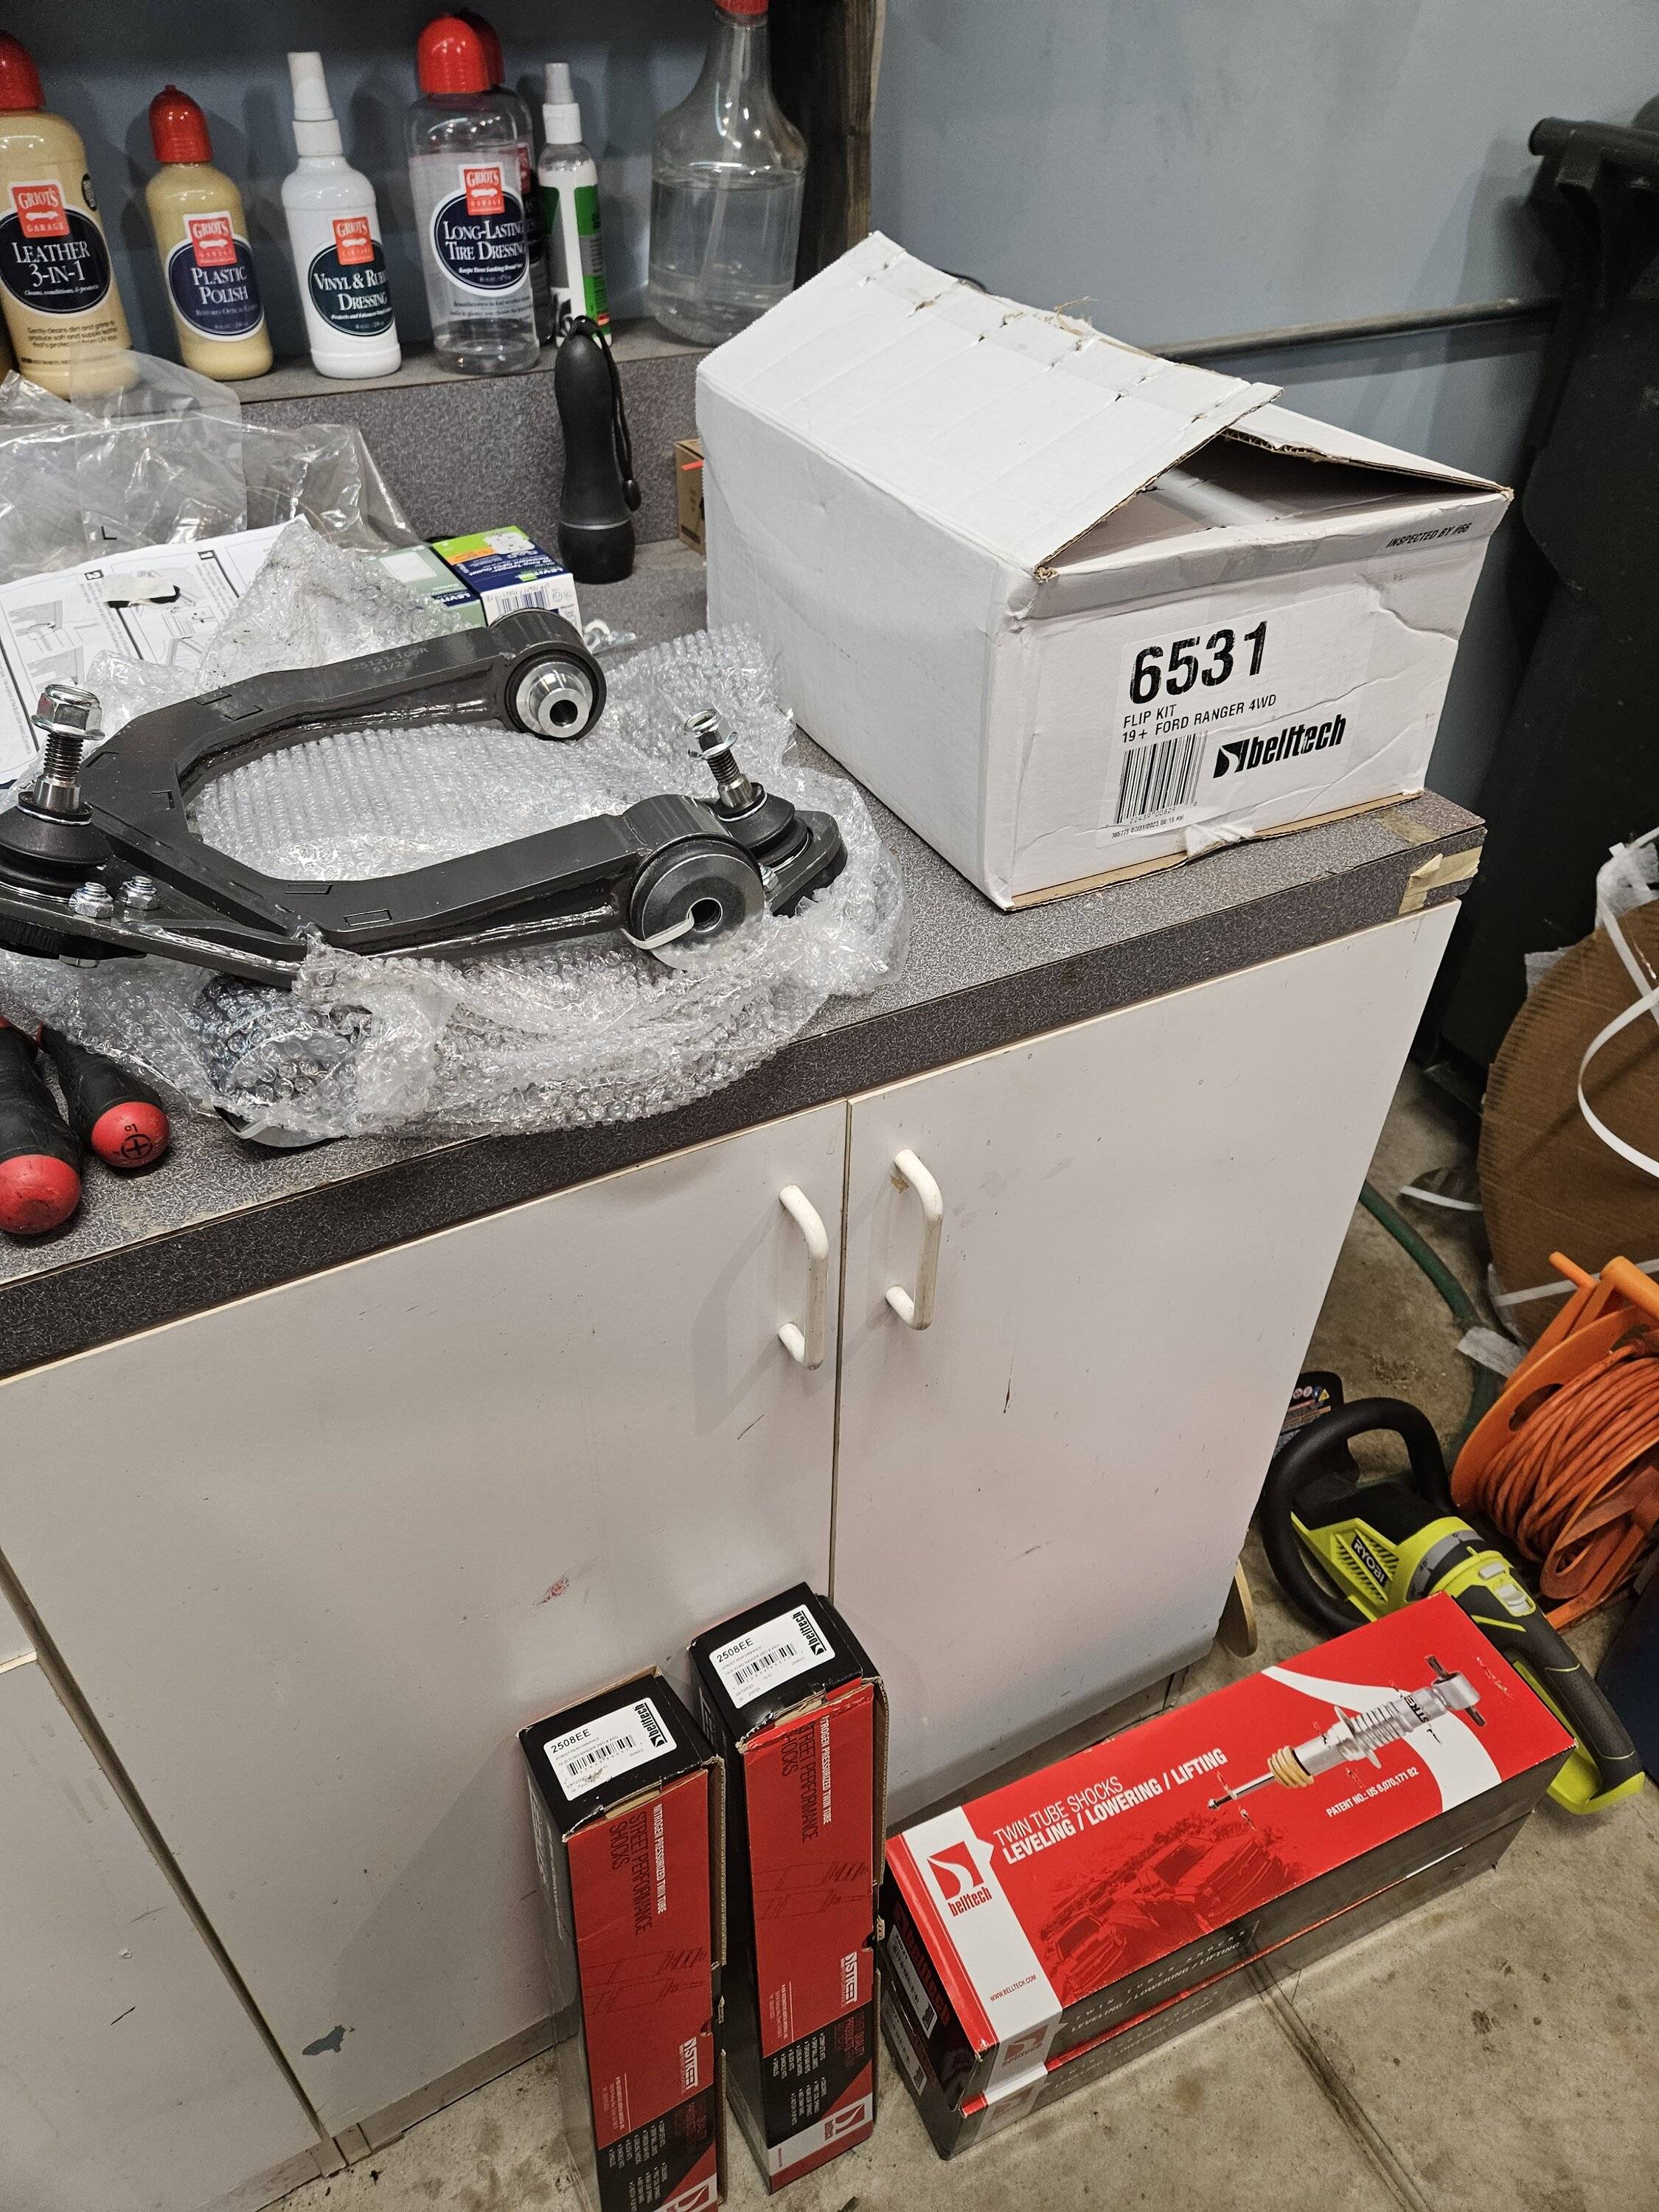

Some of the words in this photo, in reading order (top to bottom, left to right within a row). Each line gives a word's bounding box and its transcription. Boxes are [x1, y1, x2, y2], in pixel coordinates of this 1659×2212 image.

[18, 187, 59, 209] GRIOT'S
[12, 240, 91, 263] LEATHER
[445, 241, 476, 260] TIRE
[29, 260, 86, 288] 3-IN-1
[190, 266, 247, 286] PLASTIC
[313, 272, 352, 291] VINYL
[352, 272, 364, 289] &
[199, 285, 248, 305] POLISH
[337, 291, 388, 311] DRESSING
[1386, 529, 1439, 548] INSPECTED
[1438, 526, 1455, 538] BY
[1130, 620, 1268, 704] 6531
[1122, 728, 1148, 743] 19+
[1155, 716, 1189, 735] FORD
[1194, 702, 1245, 726] RANGER
[1248, 694, 1277, 711] 4WD
[1123, 711, 1152, 728] FLIP
[1156, 703, 1178, 721] KIT
[1246, 714, 1347, 770] belltech
[1352, 1538, 1387, 1582] RYOBI
[790, 1610, 818, 1646] belltech
[714, 1637, 755, 1663] 2508EE
[632, 1702, 660, 1738] belltech
[549, 1727, 592, 1754] 2508EE
[821, 1746, 831, 1791] PRESSURIZED
[800, 1762, 818, 1844] PERFORMANCE
[993, 1815, 1033, 1846] TWIN
[1029, 1801, 1069, 1828] TUBE
[1067, 1775, 1124, 1813] SHOCKS
[1002, 1819, 1077, 1865] LEVELING
[1085, 1778, 1164, 1826] LOWERING
[1171, 1747, 1228, 1784] LIFTING
[1326, 1798, 1354, 1818] PATENT
[1366, 1787, 1379, 1798] US
[1376, 1772, 1409, 1792] 8,070,171
[1407, 1767, 1419, 1778] B2
[629, 1811, 648, 1854] STREET
[653, 1803, 664, 1839] NITROGEN
[609, 1820, 630, 1871] SHOCKS
[655, 1834, 665, 1881] PRESSURIZED
[630, 1851, 653, 1936] PERFORMANCE
[948, 1886, 992, 1917] belltech
[990, 1974, 1037, 2003] WWW.BELLTECH.COM
[1071, 2003, 1122, 2033] LEVELING
[1134, 1966, 1189, 2000] LOWERING
[1200, 1942, 1240, 1965] LIFTING
